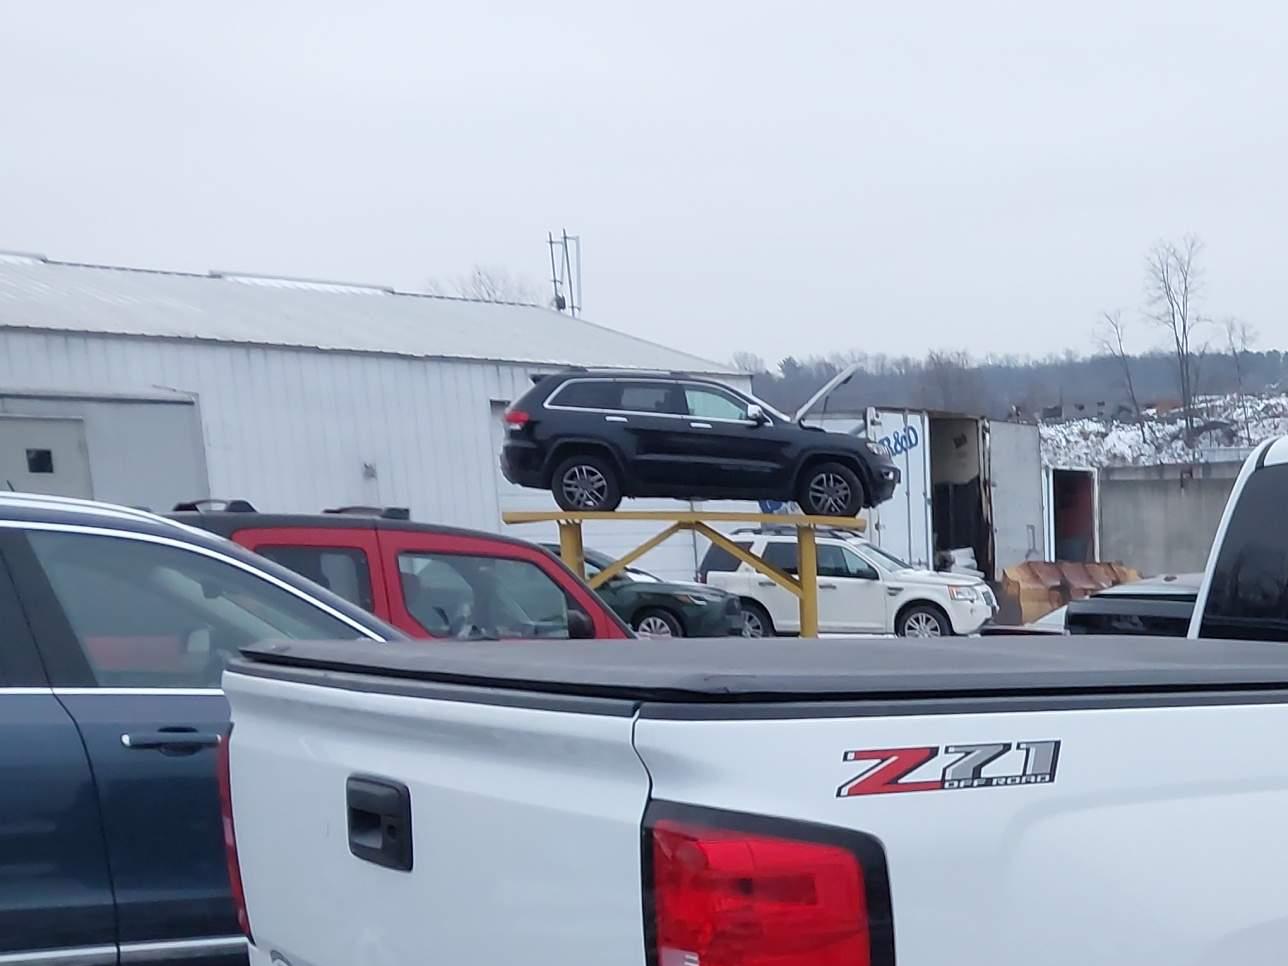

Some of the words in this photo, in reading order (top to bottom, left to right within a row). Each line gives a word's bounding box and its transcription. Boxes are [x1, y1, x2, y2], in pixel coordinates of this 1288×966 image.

[836, 740, 1061, 797] Z71
[944, 777, 987, 790] OFF
[991, 774, 1052, 787] ROAD
